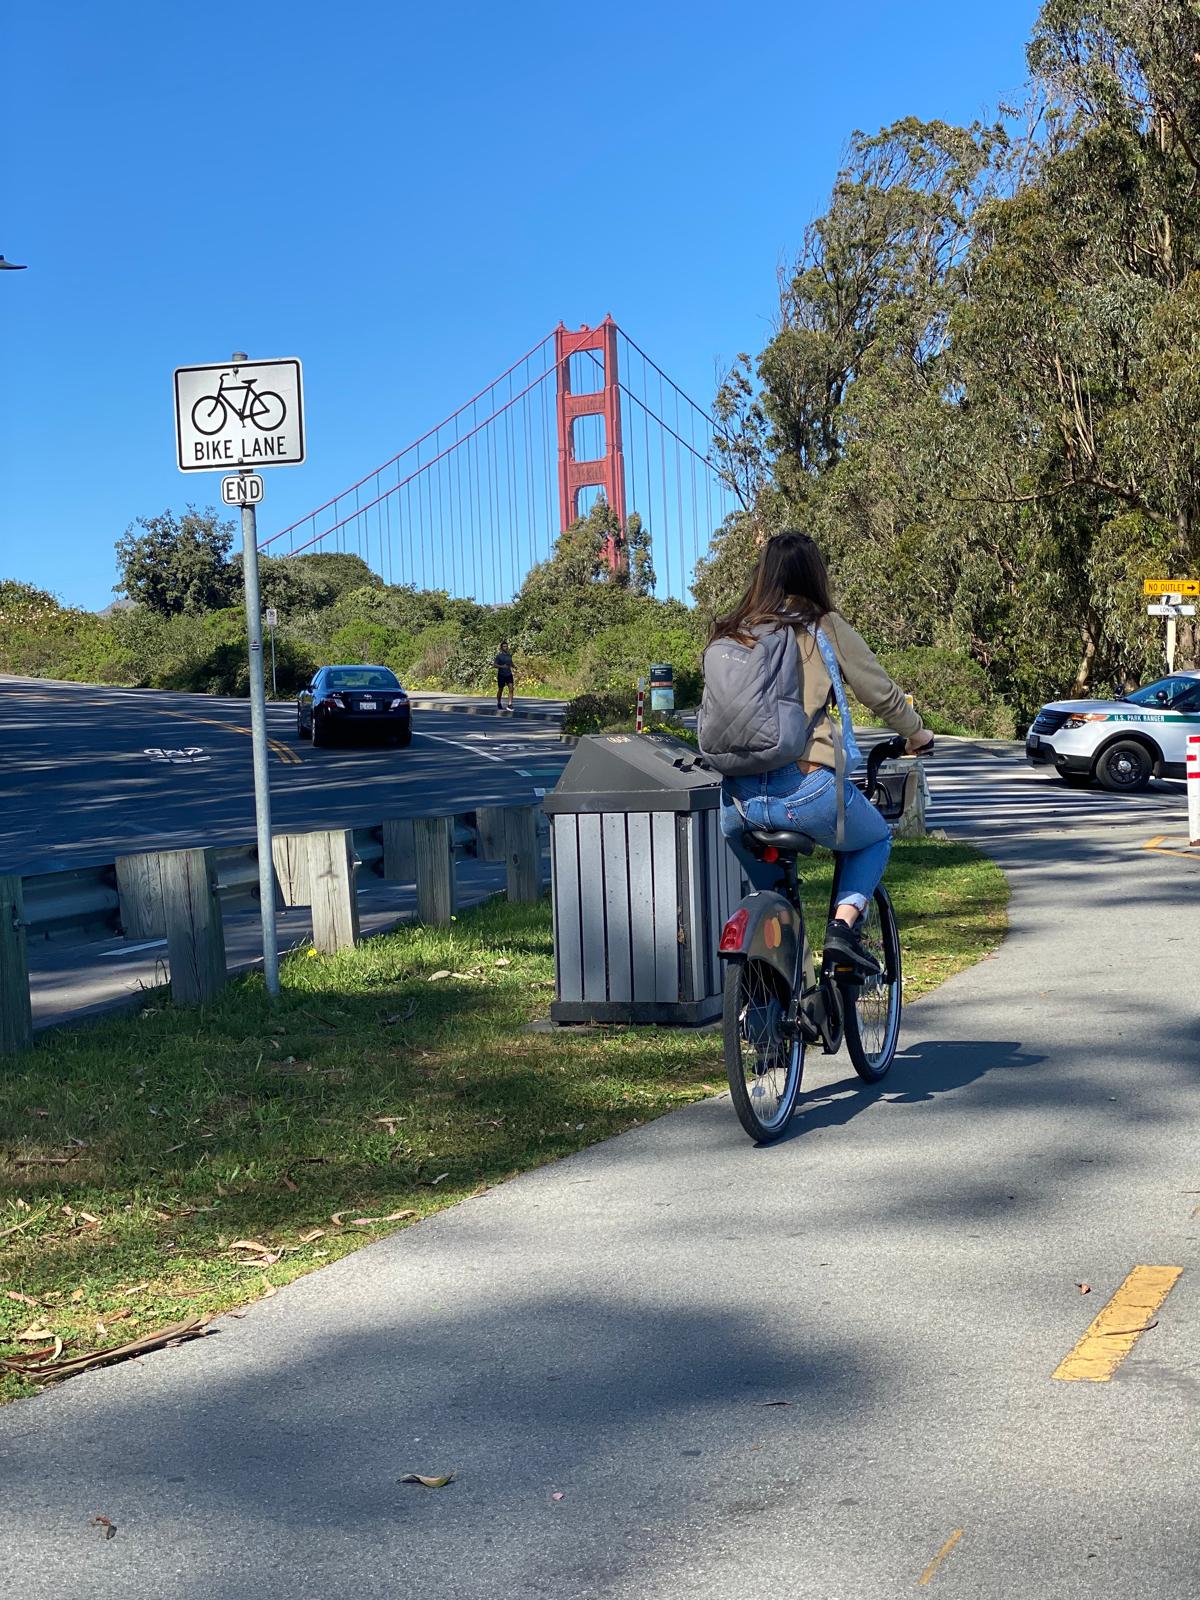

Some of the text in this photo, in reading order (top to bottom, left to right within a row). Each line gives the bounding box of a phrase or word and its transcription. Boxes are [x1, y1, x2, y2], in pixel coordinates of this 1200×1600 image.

[194, 436, 287, 461] BIKE LANE
[226, 480, 260, 501] END
[1148, 583, 1185, 592] NO OUTLET
[829, 664, 844, 702] adidas
